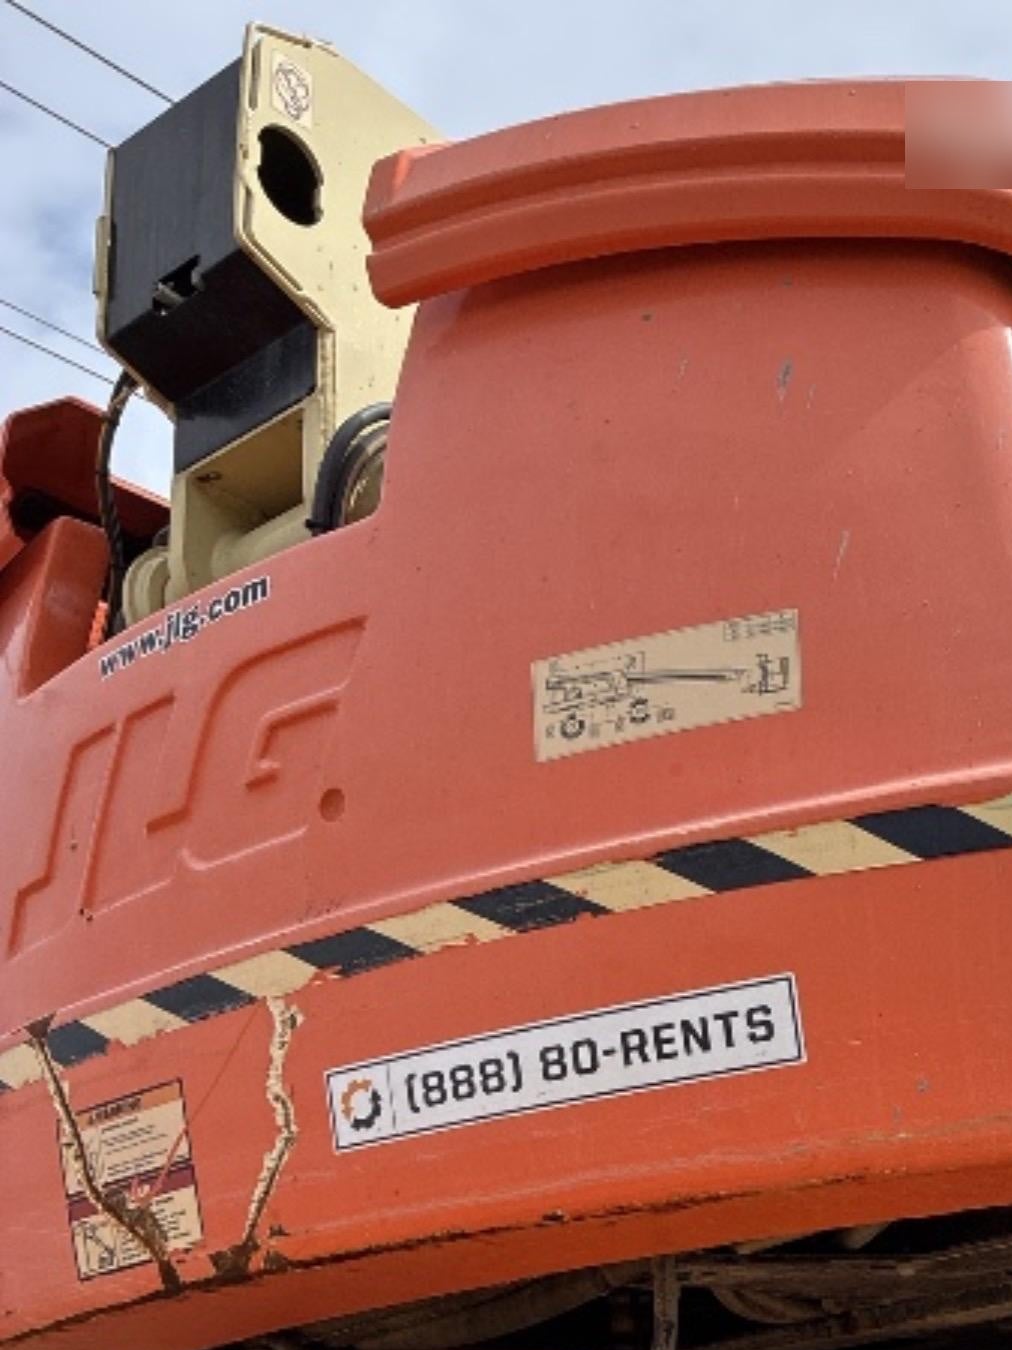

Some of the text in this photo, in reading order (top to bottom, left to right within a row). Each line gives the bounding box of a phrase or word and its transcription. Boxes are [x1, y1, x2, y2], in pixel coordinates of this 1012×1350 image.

[99, 575, 270, 680] www.jlg.com
[8, 615, 368, 962] JLG
[405, 1004, 776, 1114] (888) 80-RENTS
